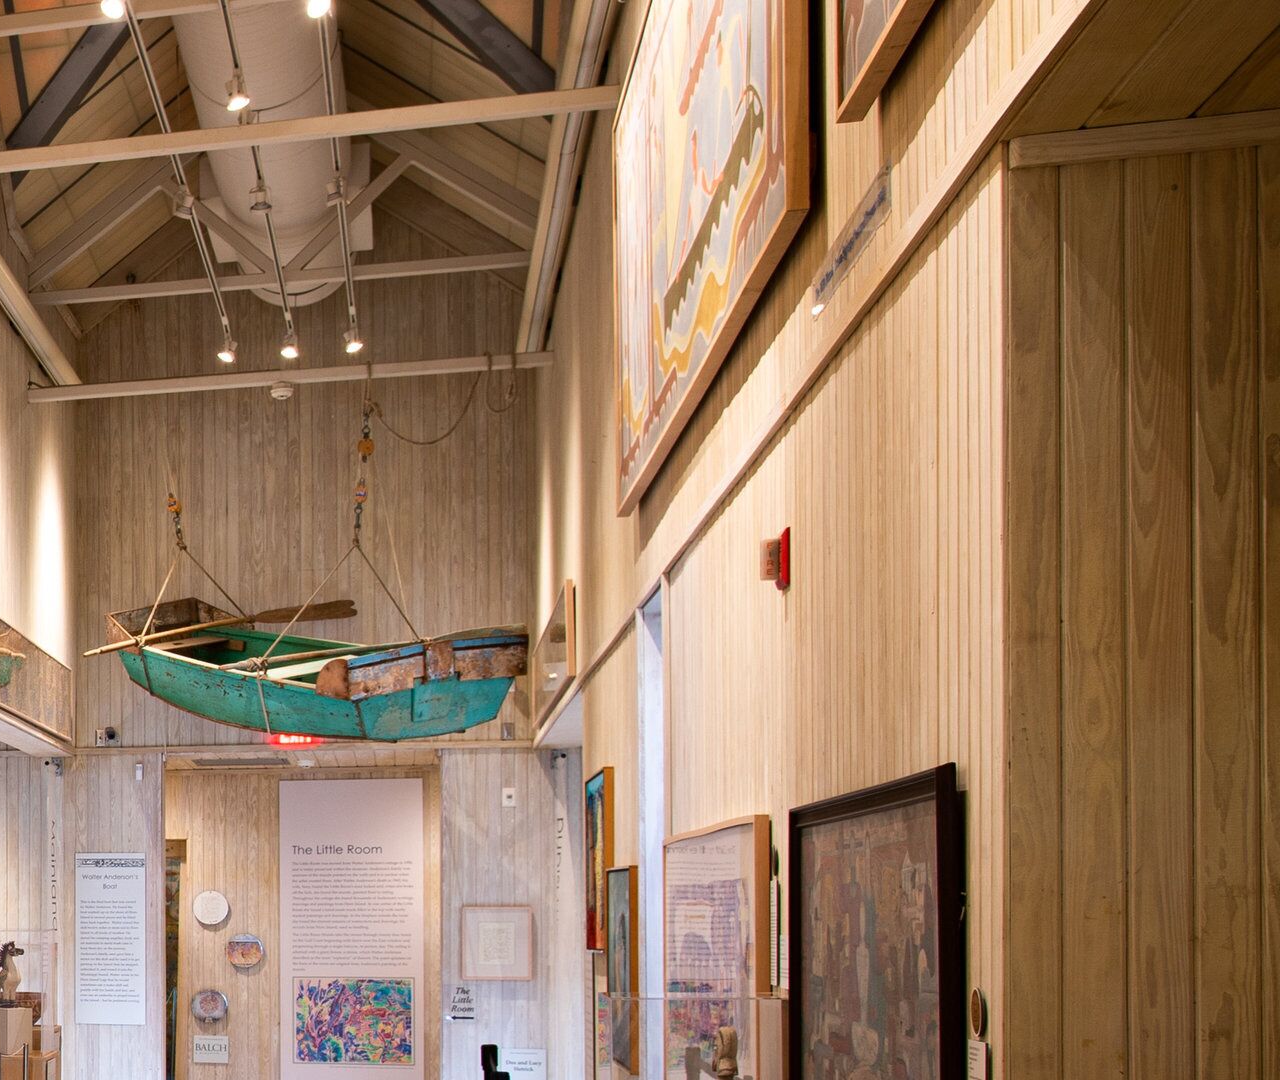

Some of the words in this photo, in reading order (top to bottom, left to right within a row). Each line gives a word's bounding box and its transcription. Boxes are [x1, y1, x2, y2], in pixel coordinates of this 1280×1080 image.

[292, 845, 313, 855] The
[316, 844, 343, 855] Little
[347, 844, 383, 855] Room
[455, 987, 470, 995] The
[452, 996, 474, 1004] Little
[195, 1043, 227, 1052] BALCH
